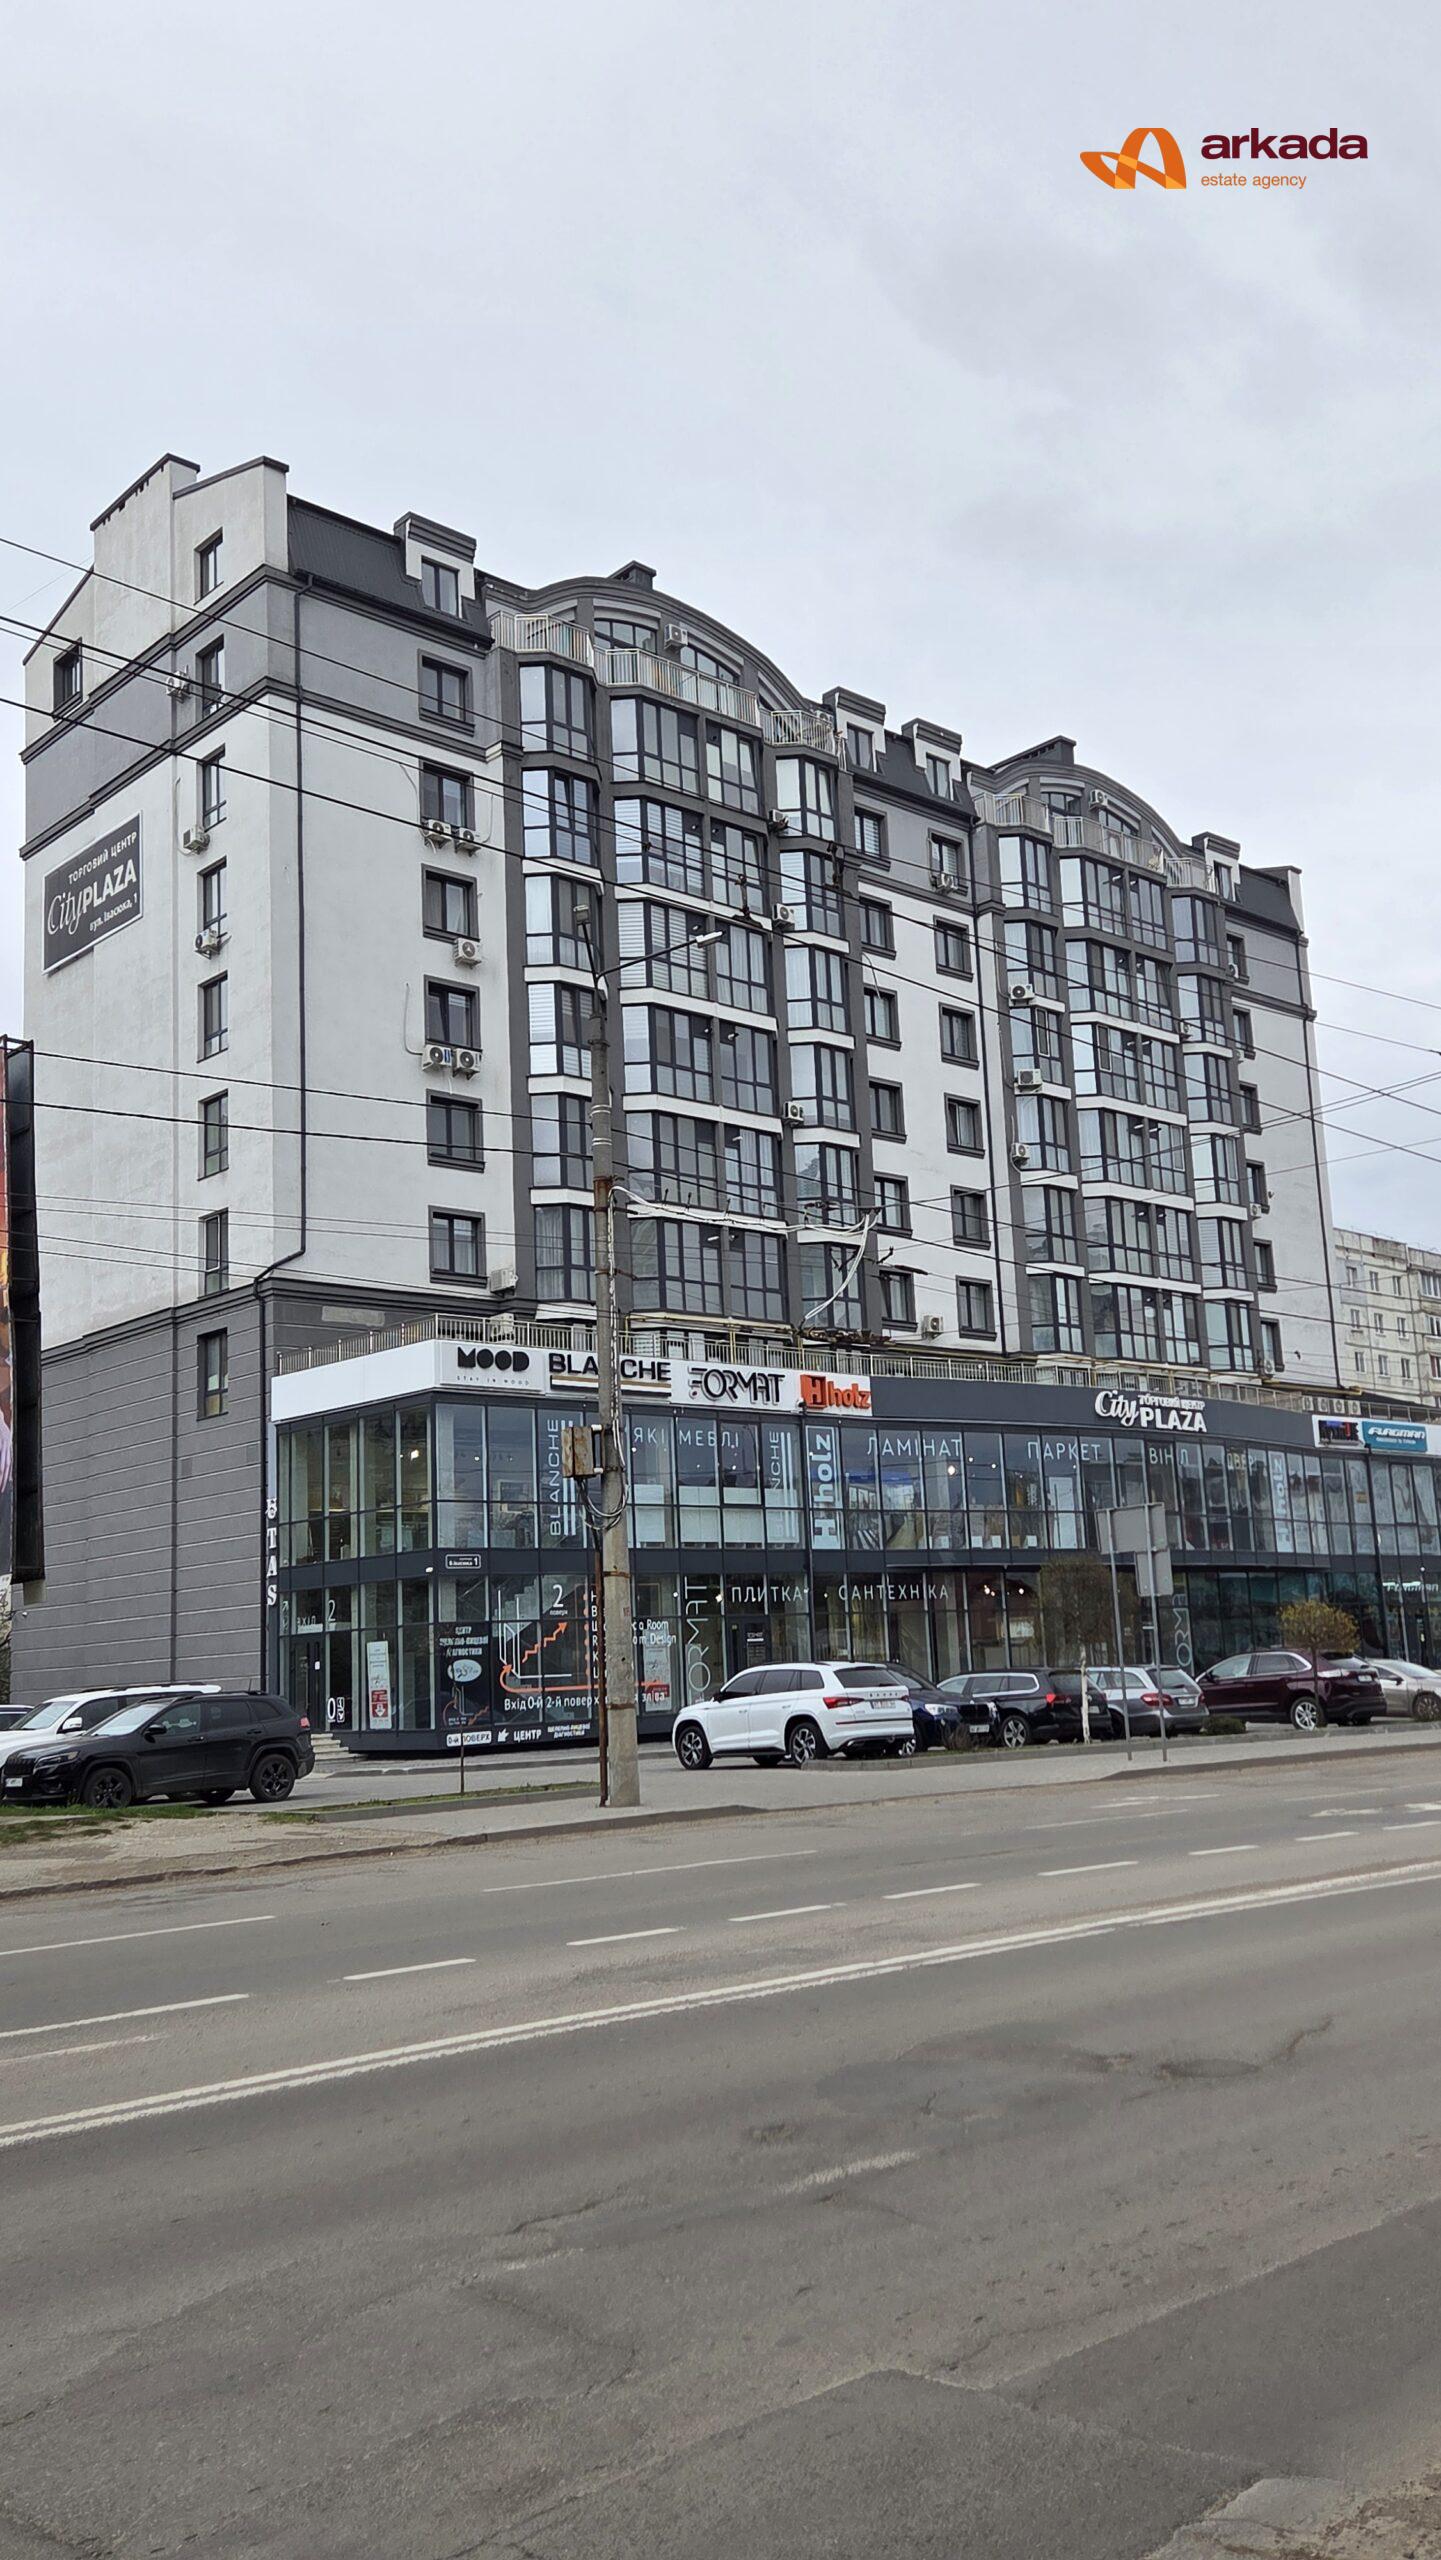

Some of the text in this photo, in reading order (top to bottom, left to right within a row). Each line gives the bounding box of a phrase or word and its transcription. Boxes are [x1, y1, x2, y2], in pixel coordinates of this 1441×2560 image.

[68, 831, 137, 885] ТОРГОВИЙ ЦЕНТР
[133, 892, 138, 904] 1
[457, 1347, 530, 1372] MOOD
[549, 1352, 672, 1381] BLACHE
[1094, 1390, 1207, 1433] City PLAZA
[679, 1430, 739, 1447] МЕБЛІ
[867, 1436, 961, 1457] ЛАМІНАТ
[1027, 1441, 1101, 1462] ПАРКЕТ
[1149, 1447, 1189, 1465] ВІНЛ
[547, 1419, 561, 1536] BLANCHE
[474, 1557, 478, 1566] 1
[553, 1584, 564, 1608] 2
[731, 1586, 803, 1603] ПЛИТКА
[838, 1584, 949, 1601] САНТЕХНІКА
[328, 1599, 336, 1621] 2
[646, 1619, 669, 1631] Room
[685, 1576, 712, 1692] ORMAT
[504, 1698, 526, 1711] Вхід
[546, 1696, 561, 1708] 2-й
[564, 1695, 600, 1708] поверх
[513, 1729, 541, 1742] ЦЕНТР
